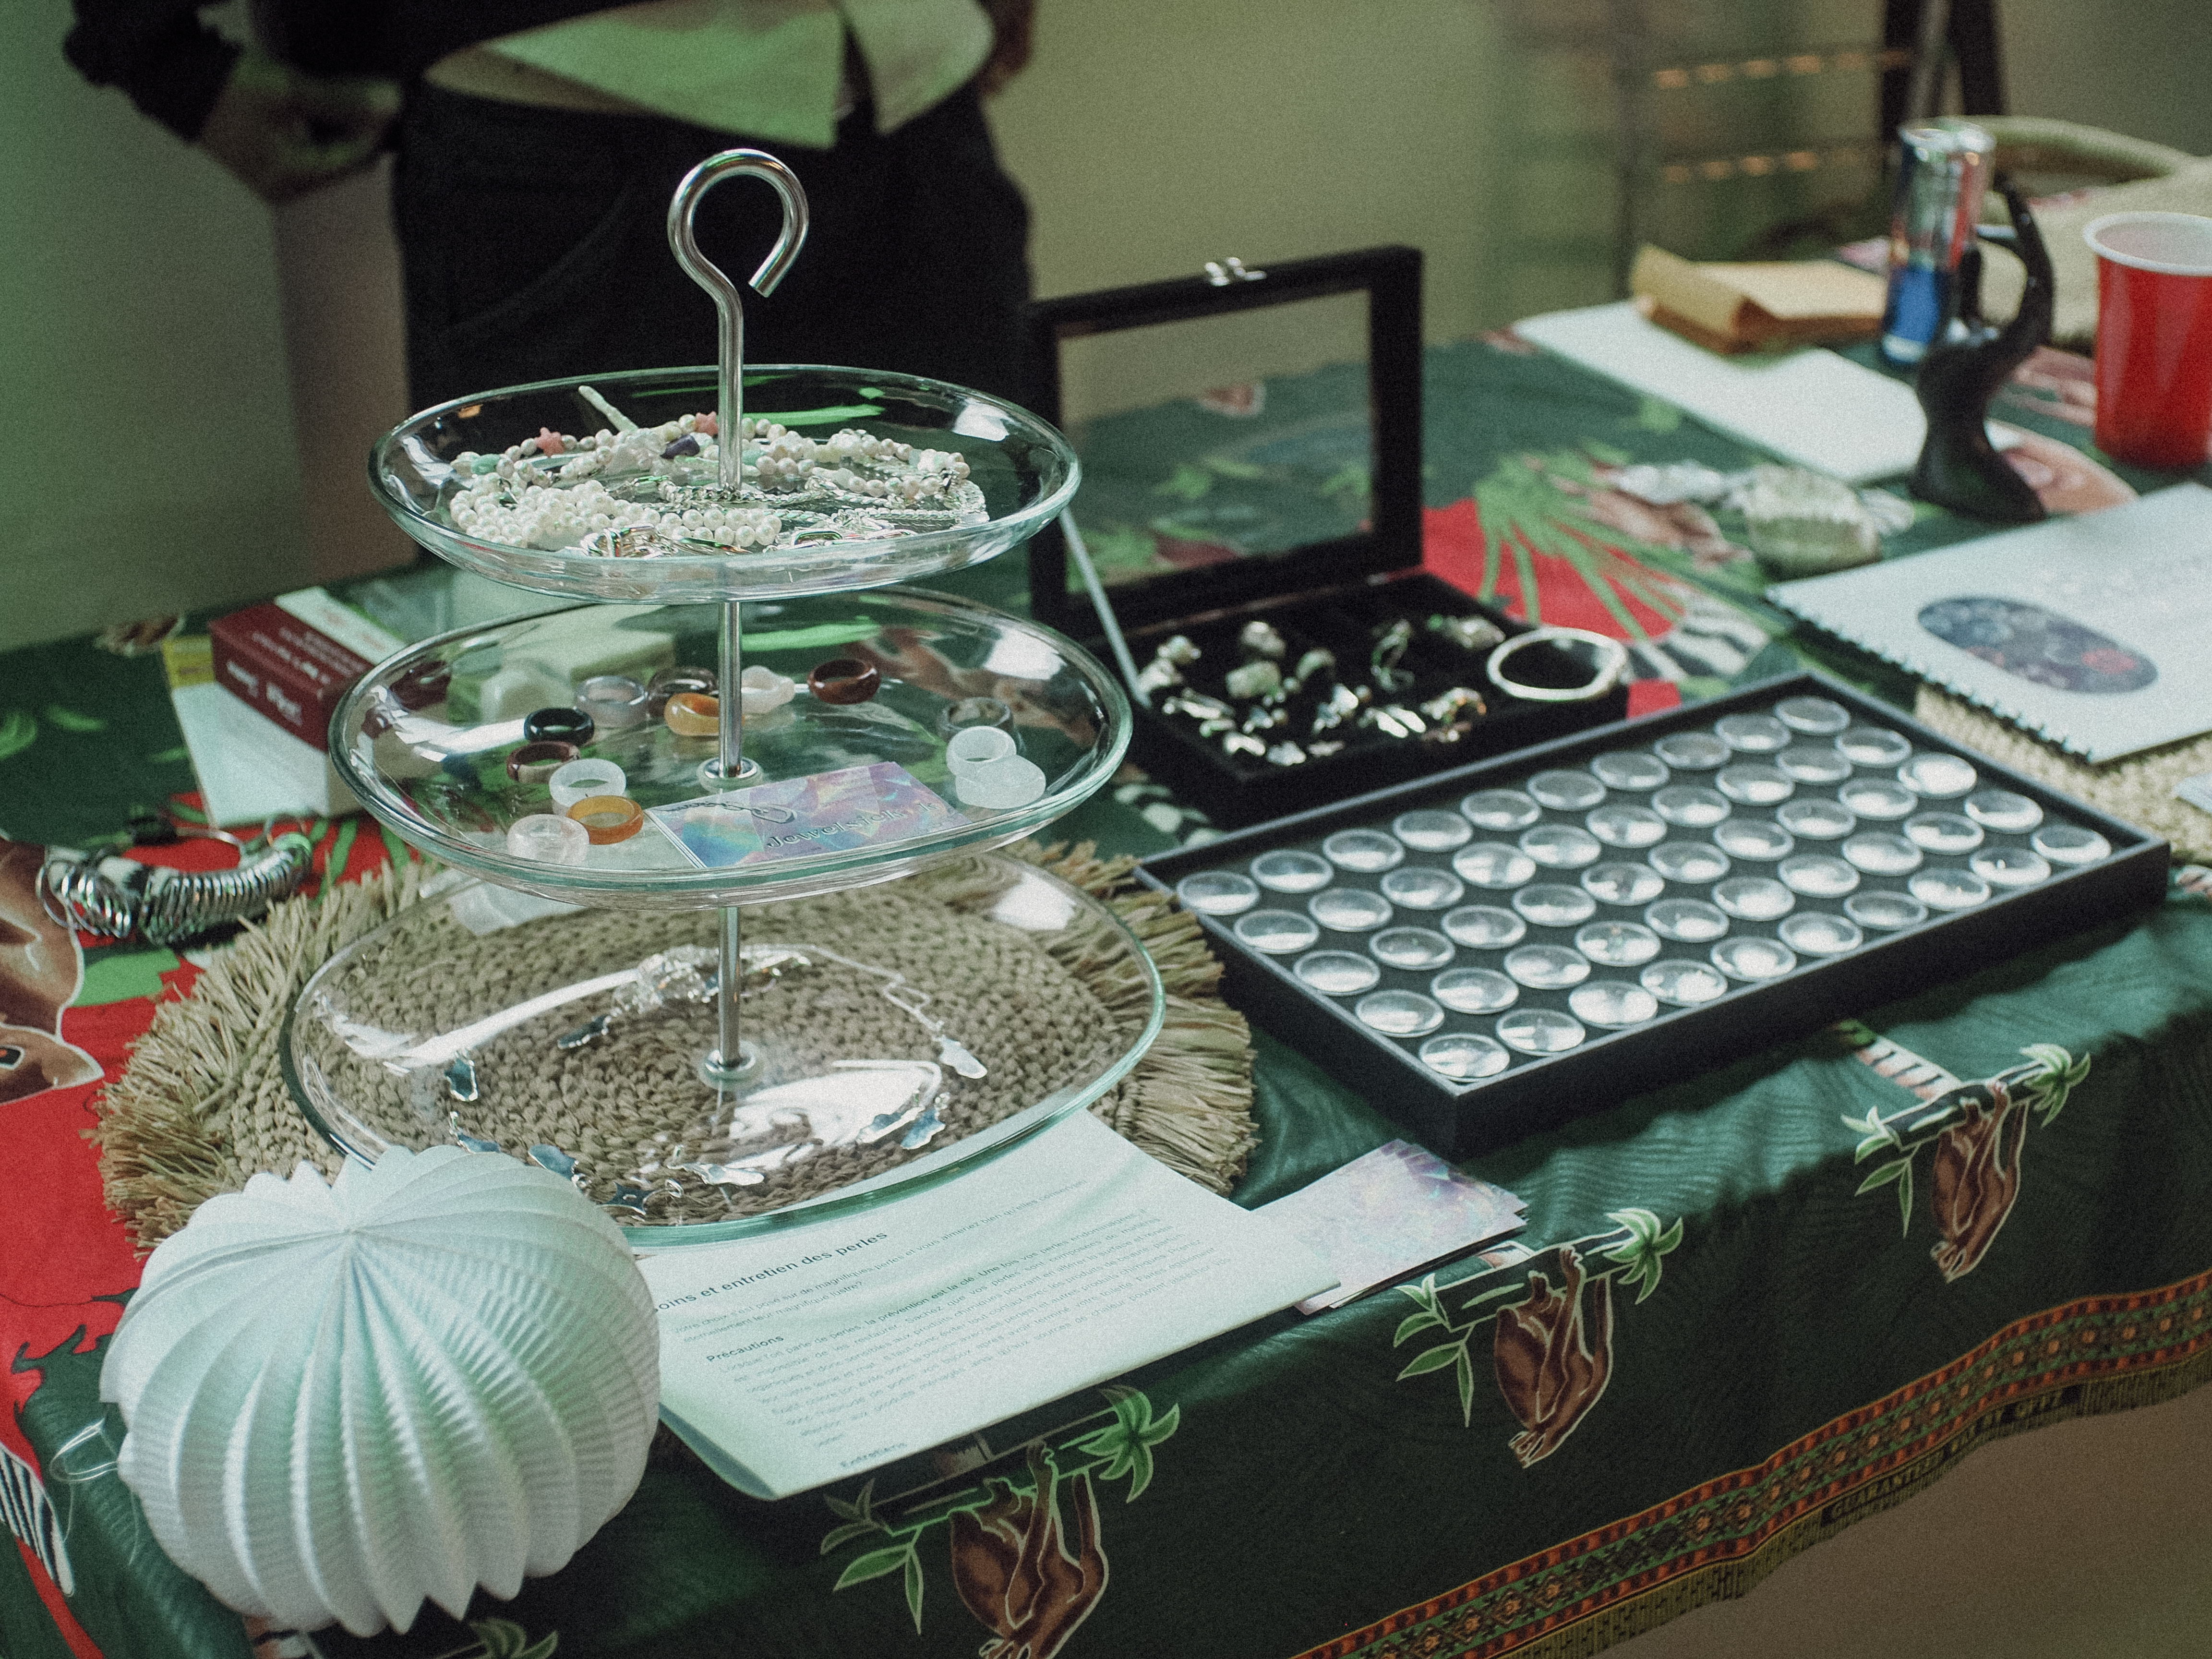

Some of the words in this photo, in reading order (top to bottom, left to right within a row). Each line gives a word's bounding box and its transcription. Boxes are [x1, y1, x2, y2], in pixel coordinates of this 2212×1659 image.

[653, 1294, 697, 1312] oins
[699, 1286, 720, 1298] et
[721, 1262, 799, 1291] entretien
[798, 1251, 833, 1265] des
[835, 1231, 889, 1256] perles
[704, 1335, 784, 1362] Précautions
